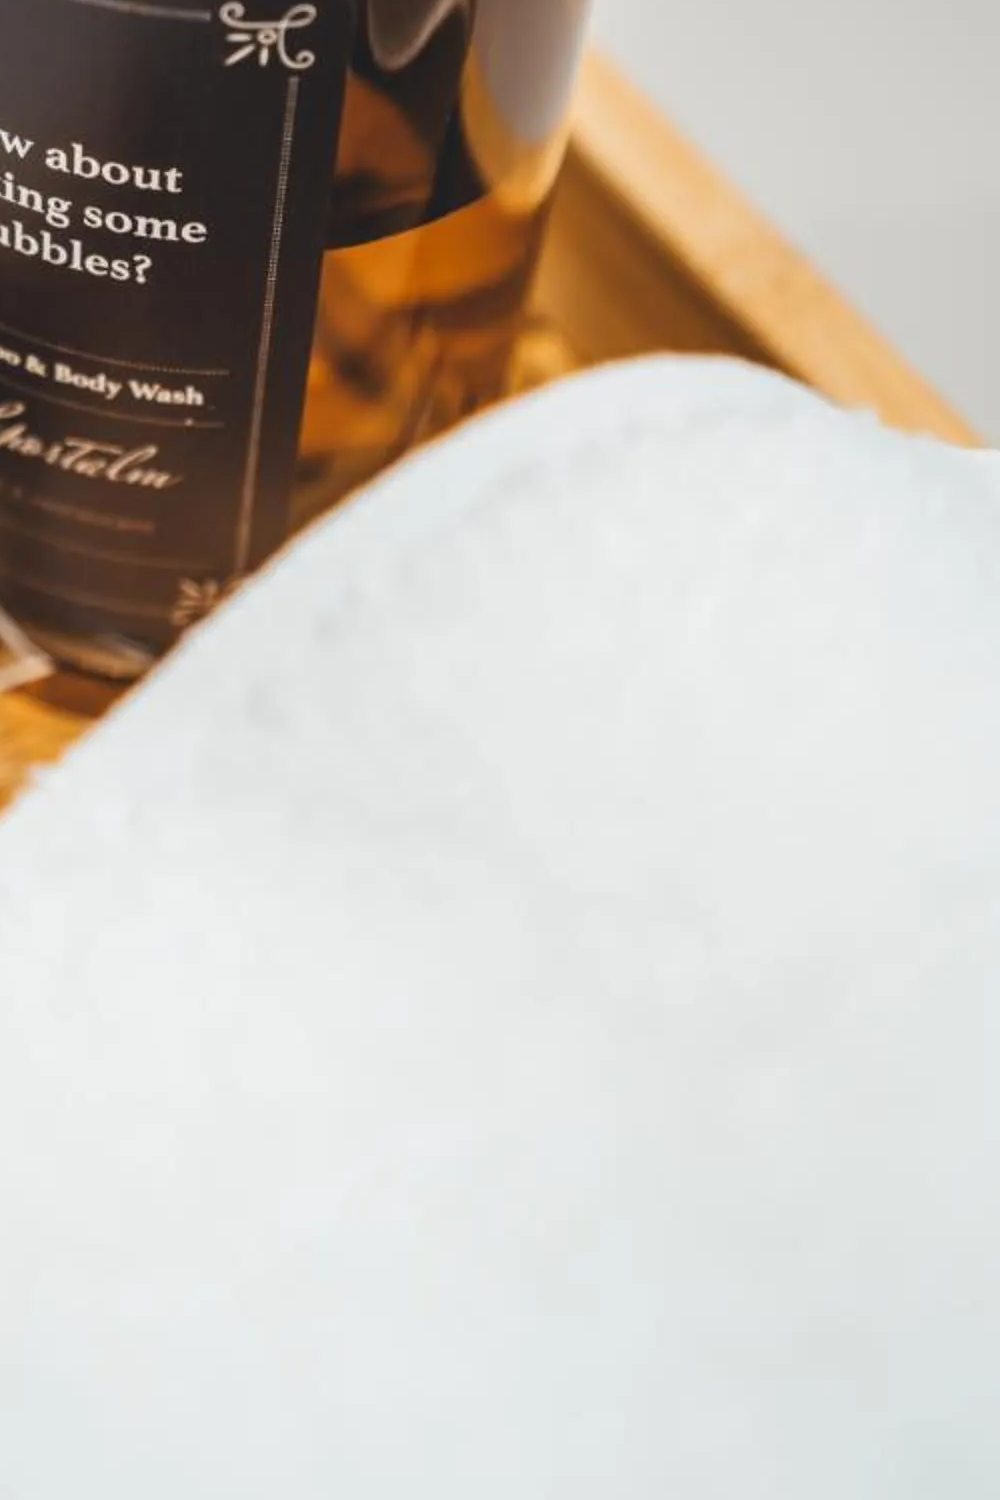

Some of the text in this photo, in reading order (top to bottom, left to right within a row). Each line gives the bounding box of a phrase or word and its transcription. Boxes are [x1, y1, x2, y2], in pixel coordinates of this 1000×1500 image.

[45, 143, 183, 193] about
[83, 204, 208, 243] some
[24, 354, 47, 377] &
[53, 362, 121, 398] Body
[128, 379, 205, 406] Wash
